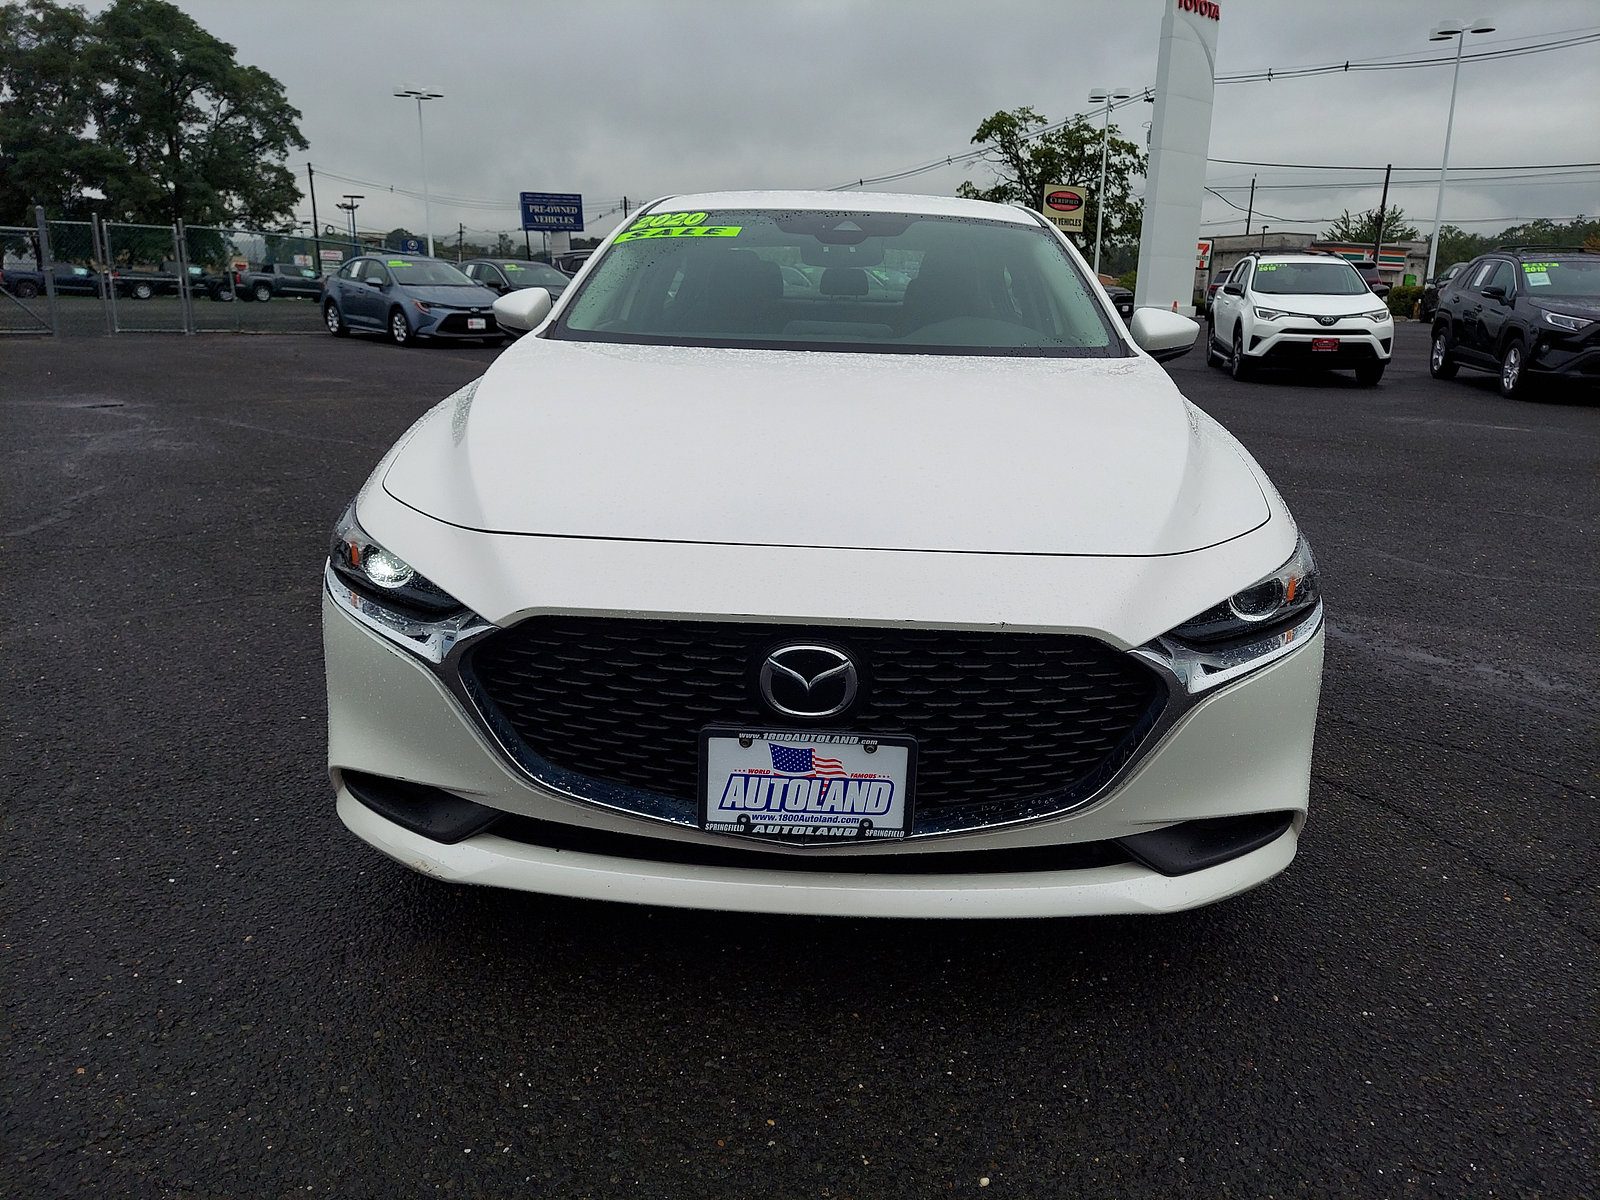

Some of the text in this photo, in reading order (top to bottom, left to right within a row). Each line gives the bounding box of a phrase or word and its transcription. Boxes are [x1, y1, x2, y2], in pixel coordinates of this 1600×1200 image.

[1178, 0, 1220, 21] TOYOTA
[529, 205, 578, 214] PRE-OWNED
[533, 215, 575, 224] VEHICLES
[630, 212, 709, 231] 2020
[1058, 217, 1082, 227] VEHICLES
[625, 227, 729, 240] SALE
[739, 732, 878, 746] www.1800AUTOLAND.com
[719, 774, 894, 815] AUTOLAND
[751, 814, 860, 825] www.1800Autoland.com
[704, 823, 905, 838] SPRINGFIELD AUTOLAND SPRINGFIELD
